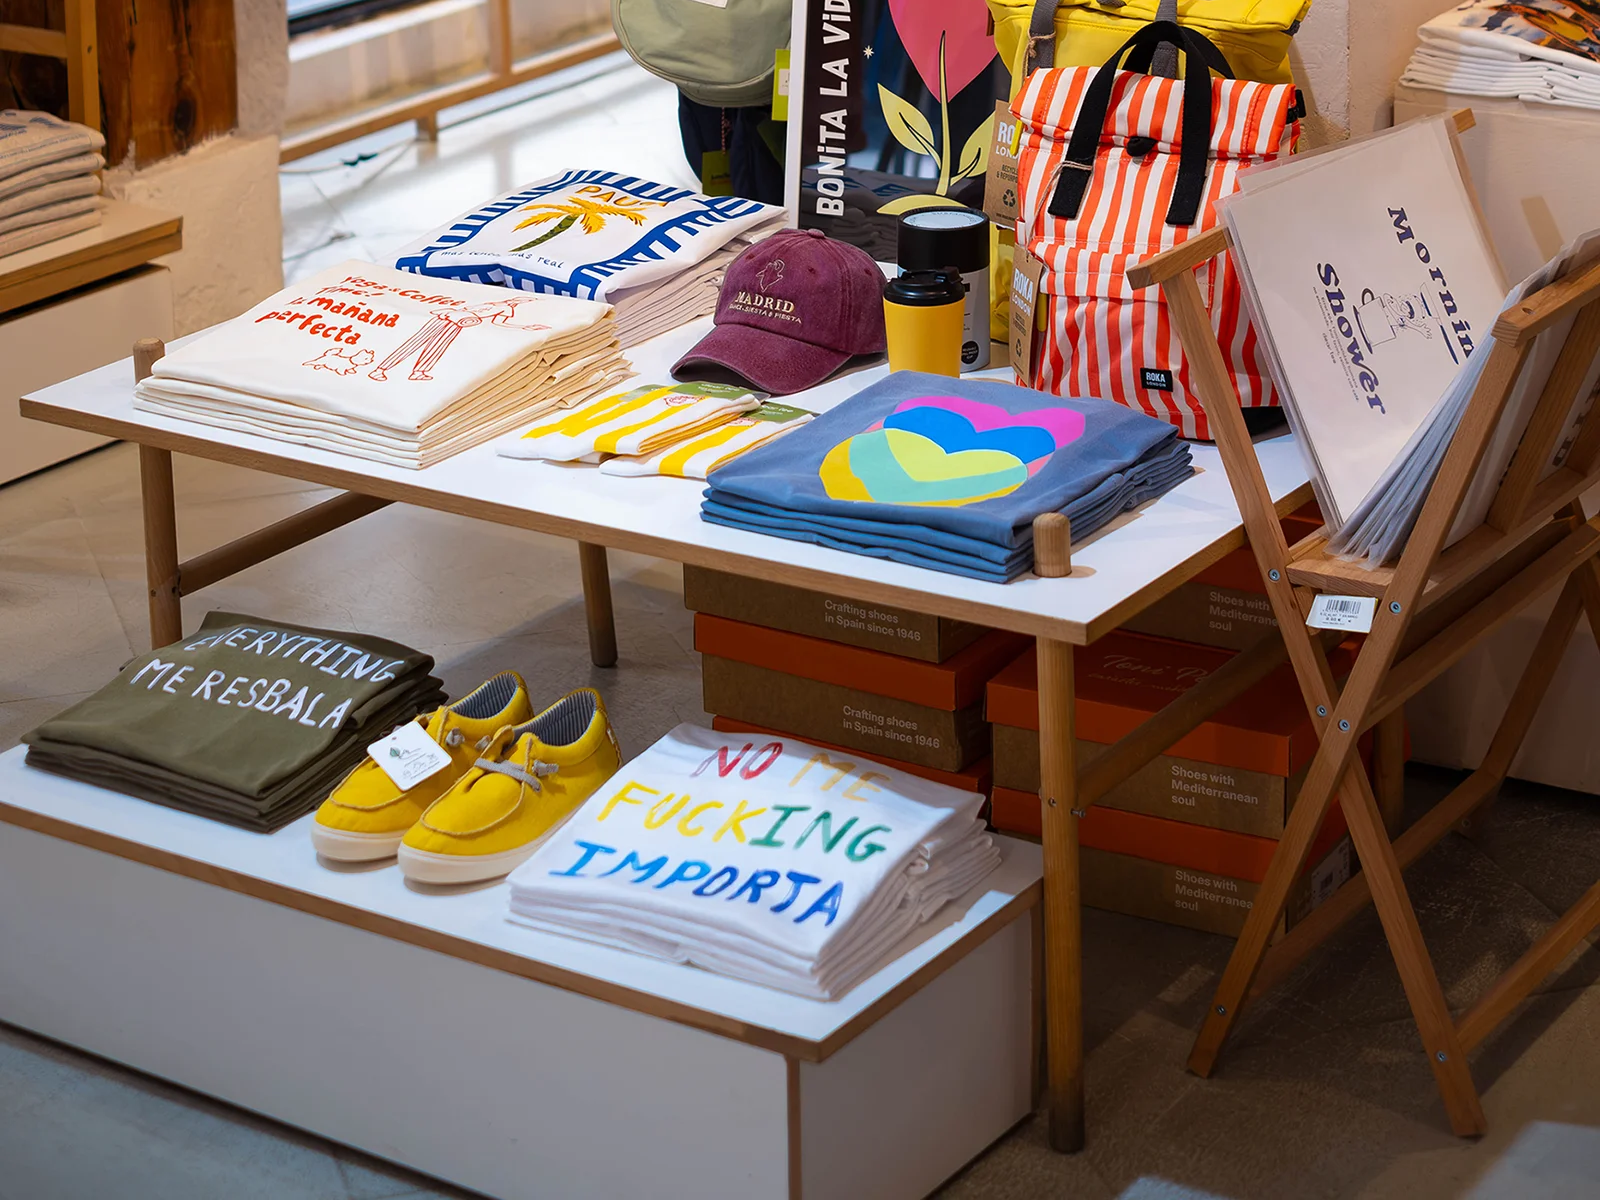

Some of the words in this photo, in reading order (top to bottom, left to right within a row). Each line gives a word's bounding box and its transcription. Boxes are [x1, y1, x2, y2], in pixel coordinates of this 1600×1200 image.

[820, 57, 850, 97] LA
[998, 121, 1015, 145] RO
[537, 256, 564, 269] real
[339, 275, 386, 291] Yoga
[399, 288, 466, 307] Coffee
[1013, 268, 1033, 304] ROKA
[1387, 206, 1475, 358] Mornin
[307, 296, 400, 328] mañana
[735, 291, 795, 313] MADRID
[1012, 291, 1031, 317] LONDON
[255, 310, 361, 345] perfecta
[774, 313, 802, 324] FIESTA
[1317, 262, 1386, 415] Shower
[1146, 372, 1166, 382] ROKA
[825, 600, 866, 619] Crafting
[868, 610, 898, 623] shoes
[1210, 591, 1244, 607] Shoes
[1246, 599, 1270, 611] with
[825, 613, 834, 623] in
[836, 615, 865, 630] Spain
[867, 623, 894, 636] since
[897, 628, 921, 641] 1946
[1209, 605, 1278, 627] Mediterrane
[1209, 620, 1232, 631] soul
[184, 627, 404, 683] EVERYTHING
[130, 658, 194, 694] ME
[191, 670, 353, 729] RESBALA
[843, 705, 884, 725] Crafting
[886, 716, 917, 730] shoes
[843, 719, 852, 729] in
[855, 721, 882, 736] Spain
[885, 729, 912, 743] since
[915, 735, 940, 748] 1946
[693, 741, 784, 780] NO
[789, 752, 894, 802] ME
[1171, 765, 1208, 781] Shoes
[1210, 774, 1235, 786] with
[1171, 779, 1259, 805] Mediterranean
[1171, 794, 1196, 807] soul
[596, 780, 893, 862] FUCKING
[549, 839, 844, 927] IMPORTA
[1175, 870, 1211, 887] Shoes
[1213, 879, 1238, 892] with
[1175, 884, 1253, 909] Mediterranea
[1175, 899, 1199, 911] soul
